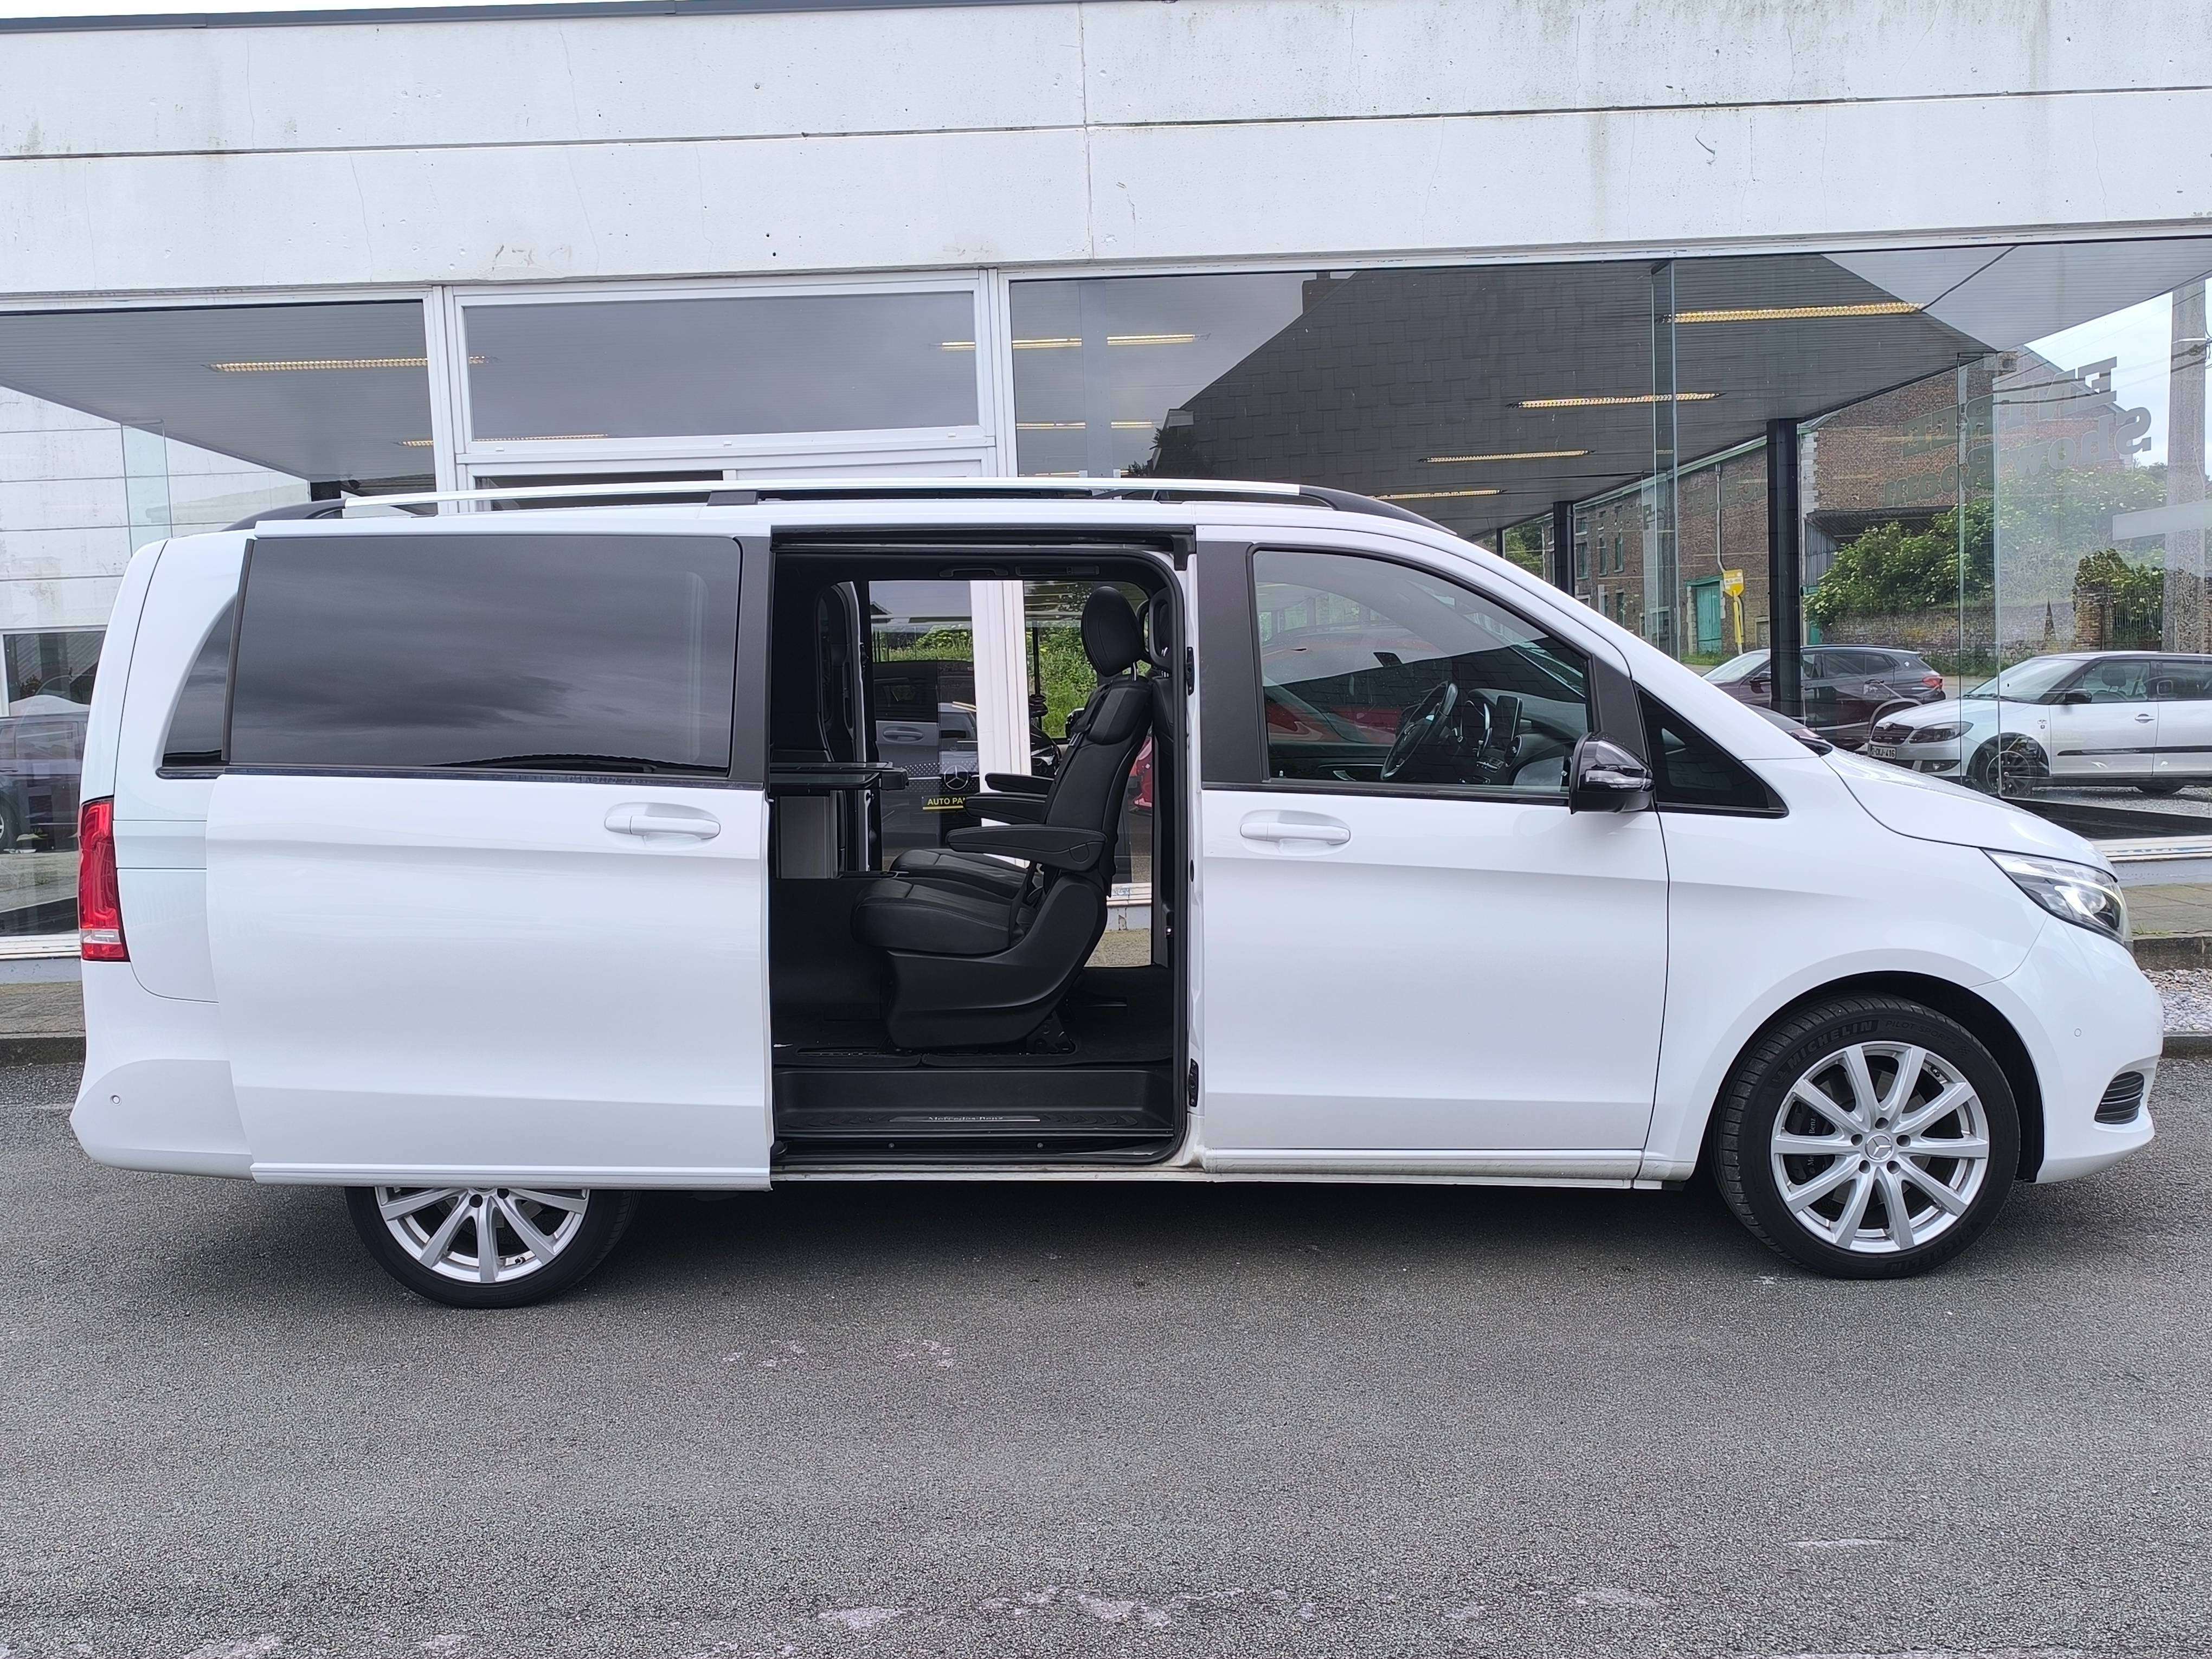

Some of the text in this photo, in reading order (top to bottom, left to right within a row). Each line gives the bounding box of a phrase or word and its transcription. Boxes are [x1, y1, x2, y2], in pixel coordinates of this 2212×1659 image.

[927, 798, 950, 806] AUTO
[1885, 1020, 1915, 1030] PILOT
[1918, 1025, 1951, 1043] SPORT
[1787, 1020, 1874, 1069] MICHELIN
